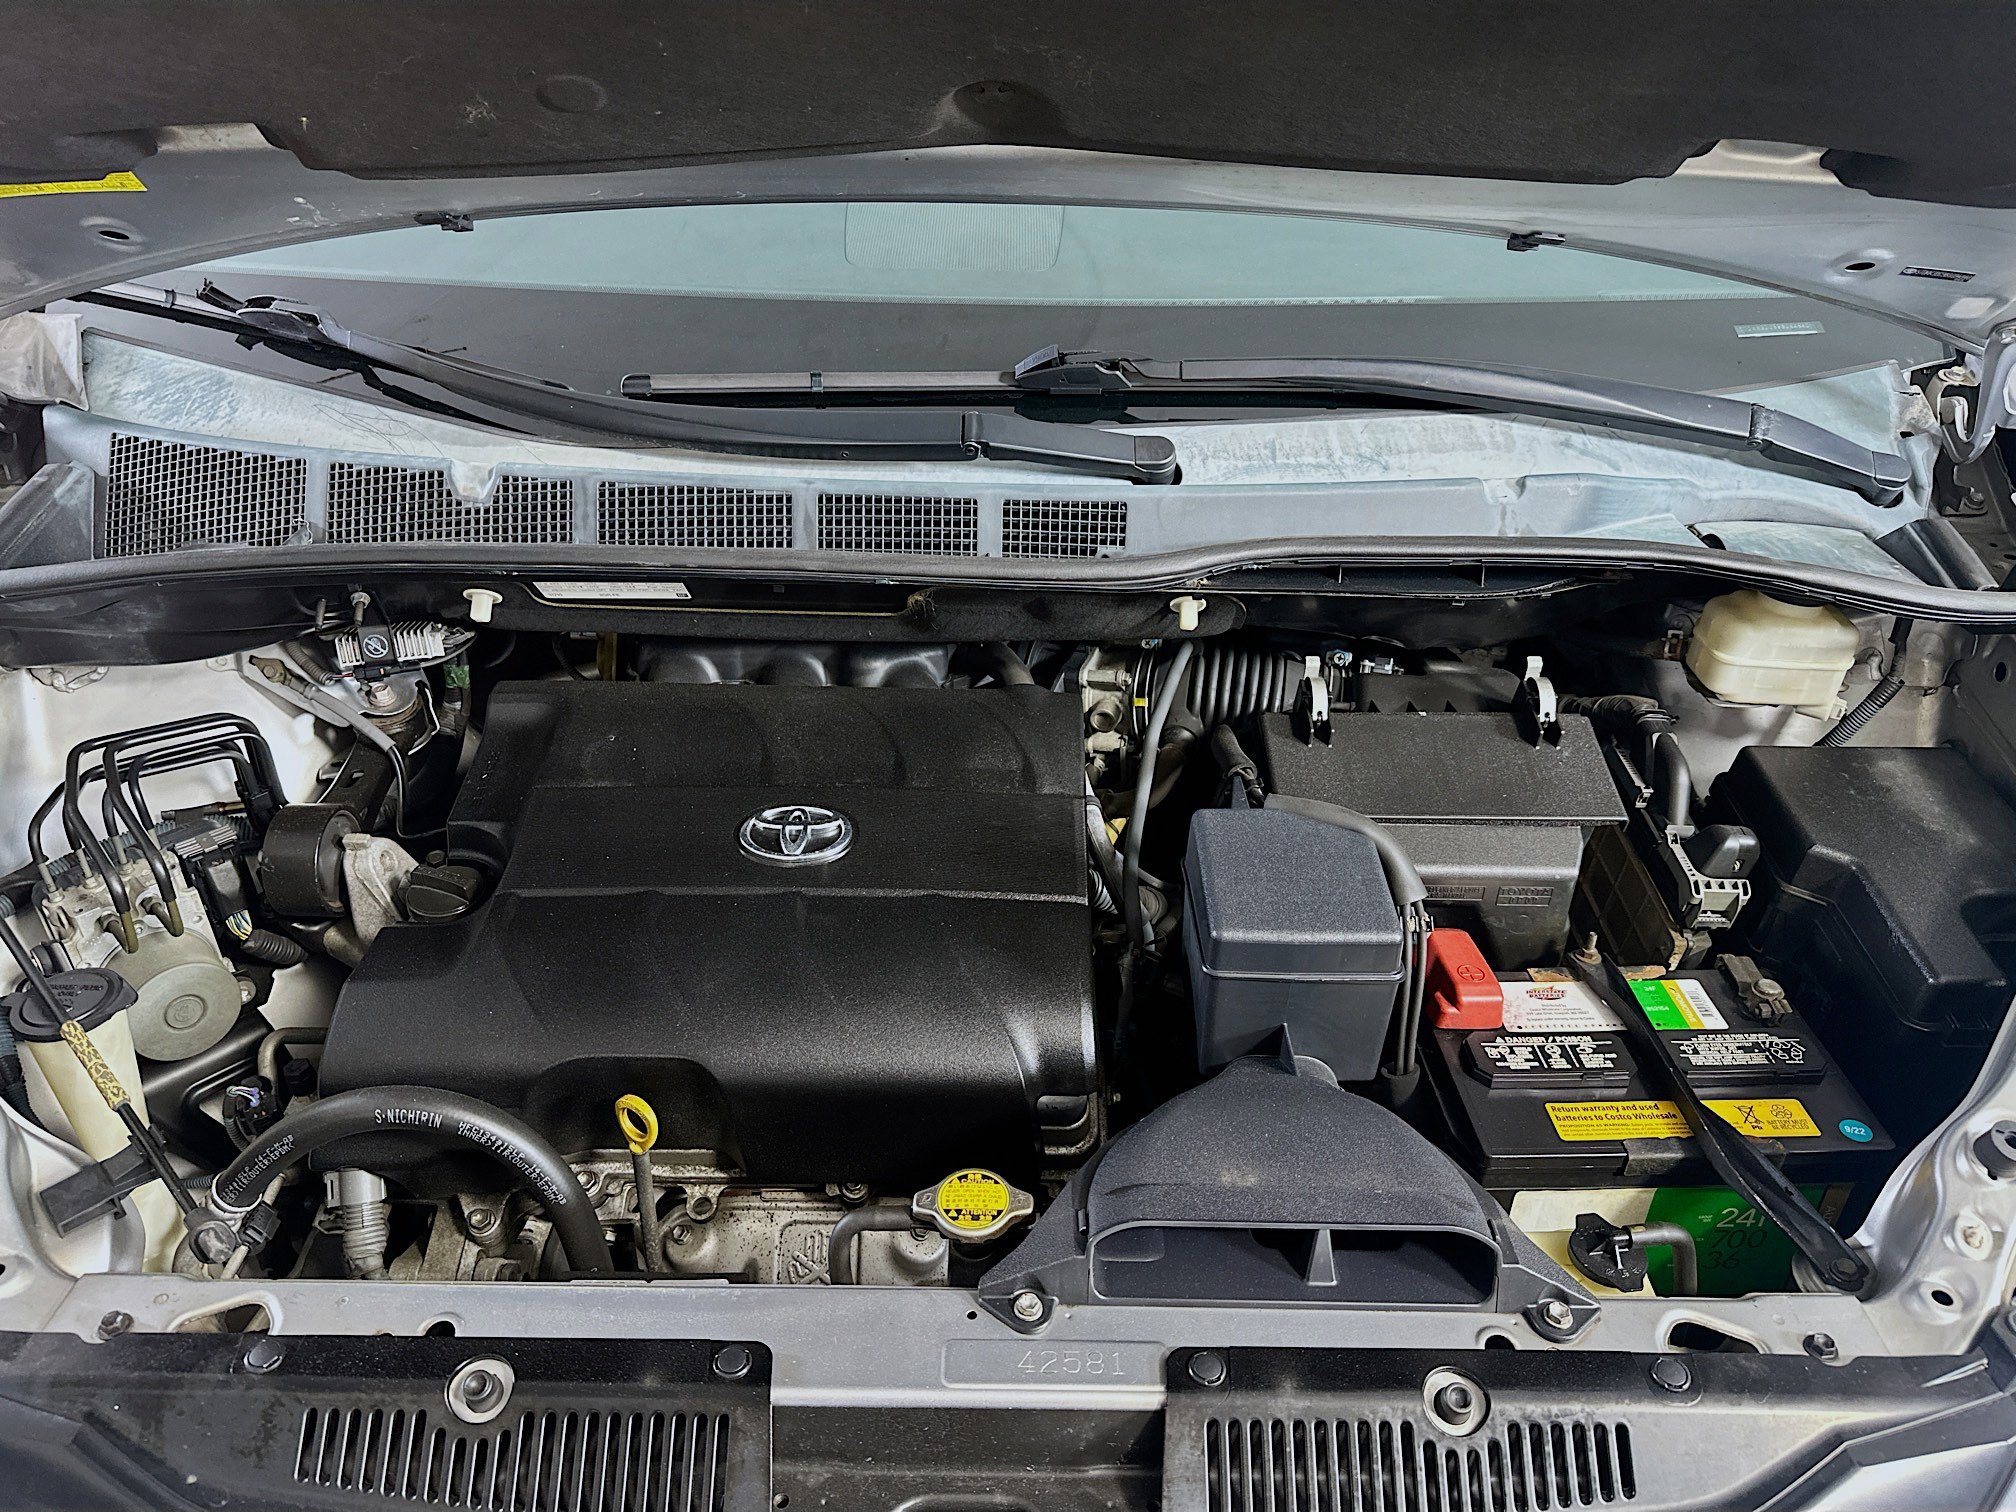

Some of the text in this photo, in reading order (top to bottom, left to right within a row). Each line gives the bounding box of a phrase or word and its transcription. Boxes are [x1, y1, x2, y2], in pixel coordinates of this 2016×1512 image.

[1581, 1105, 1620, 1113] warranty
[1638, 1103, 1659, 1111] used
[1555, 1113, 1593, 1121] batteries
[1604, 1112, 1632, 1120] Costco
[1634, 1112, 1678, 1120] Wholesale
[961, 1208, 998, 1216] ATTENTION
[1710, 1229, 1768, 1250] 700
[1702, 1251, 1741, 1270] 36
[1018, 1350, 1126, 1375] 42581
